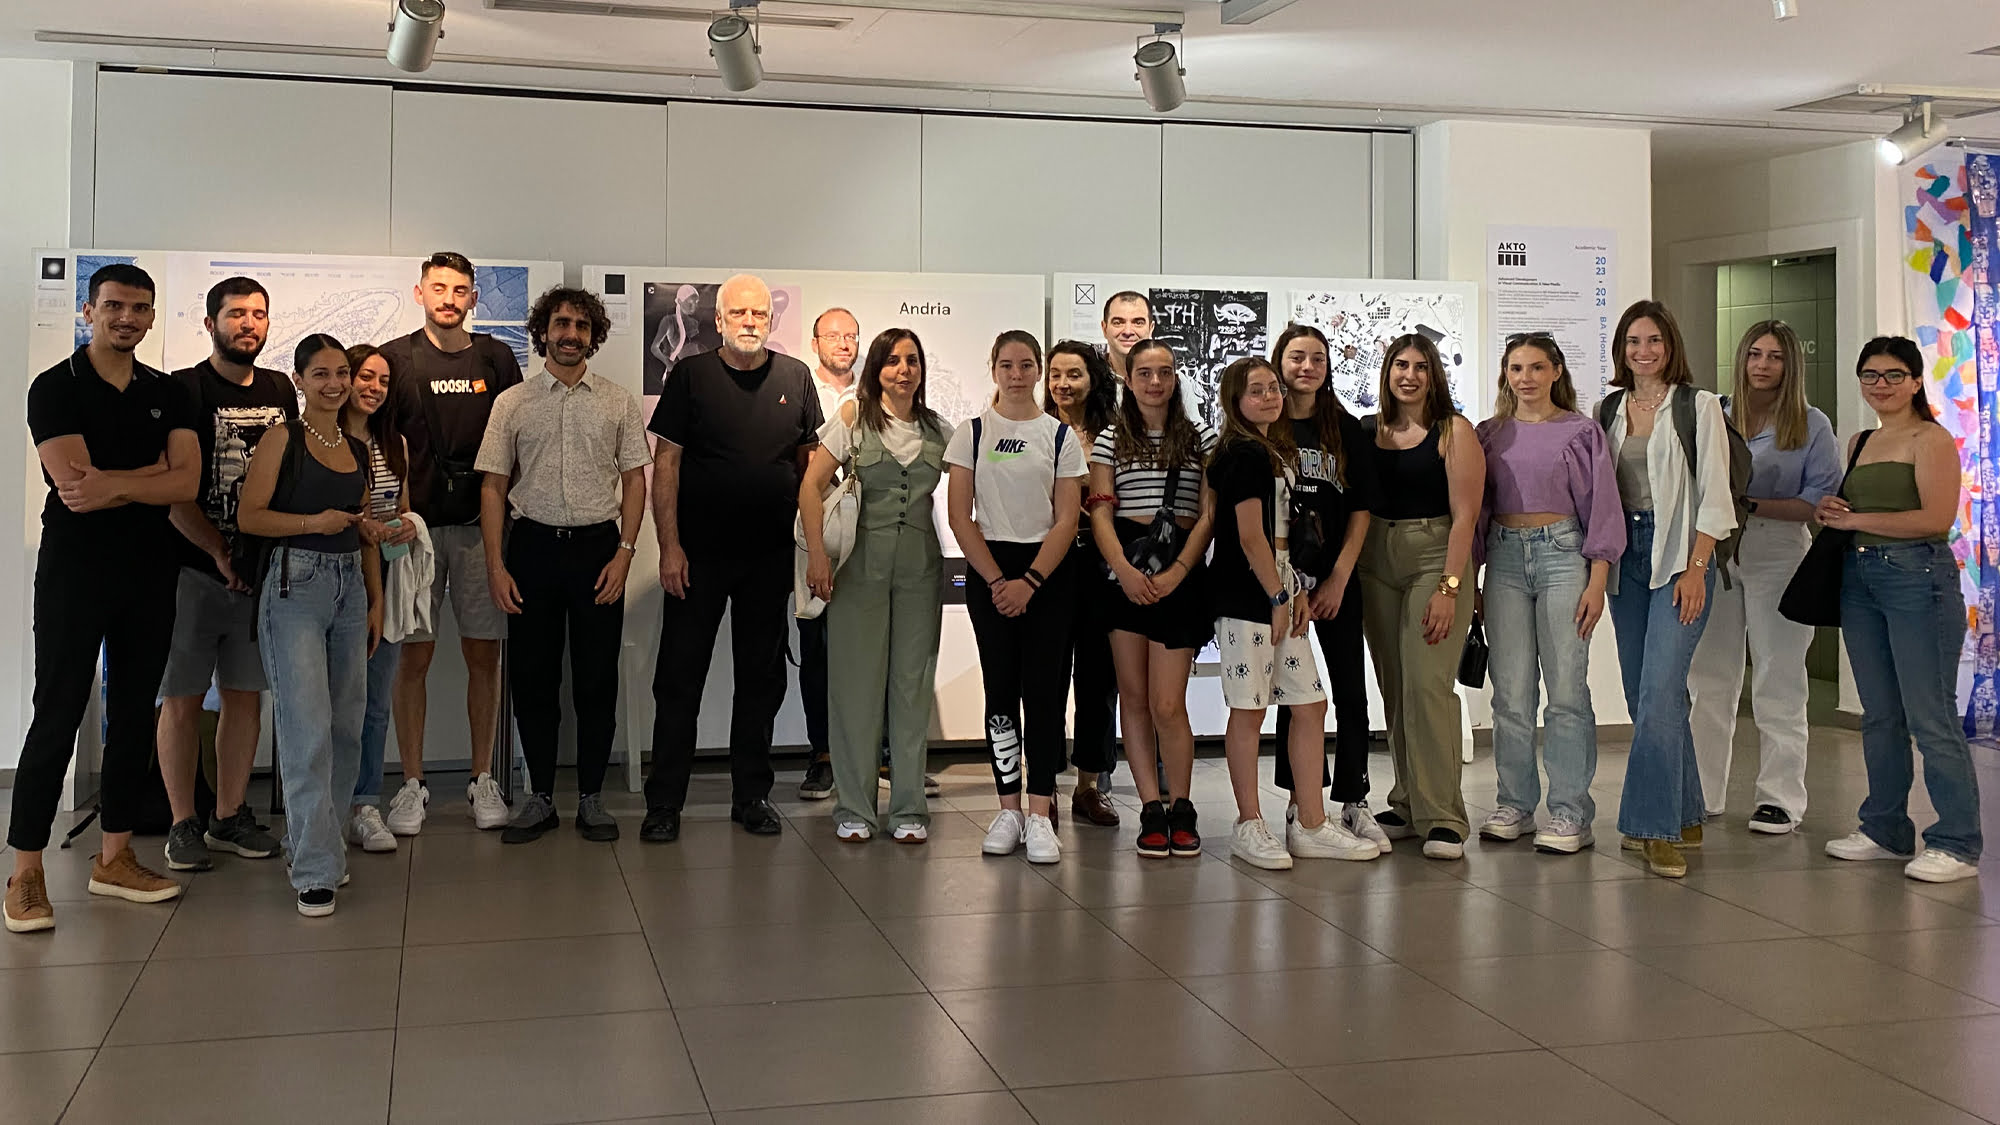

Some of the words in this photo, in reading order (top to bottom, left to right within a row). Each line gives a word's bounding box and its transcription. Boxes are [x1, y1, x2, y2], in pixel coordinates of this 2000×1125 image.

[1498, 242, 1526, 251] AKTO
[1595, 256, 1606, 265] 20
[1595, 267, 1606, 275] 23
[1595, 288, 1606, 296] 20
[1595, 298, 1606, 306] 24
[900, 301, 951, 315] Andria
[1600, 316, 1607, 330] BA
[1599, 333, 1608, 362] (Hons)
[1600, 365, 1608, 374] in
[1600, 376, 1608, 399] Grap
[994, 438, 1028, 454] NIKE
[1302, 485, 1318, 493] COAST
